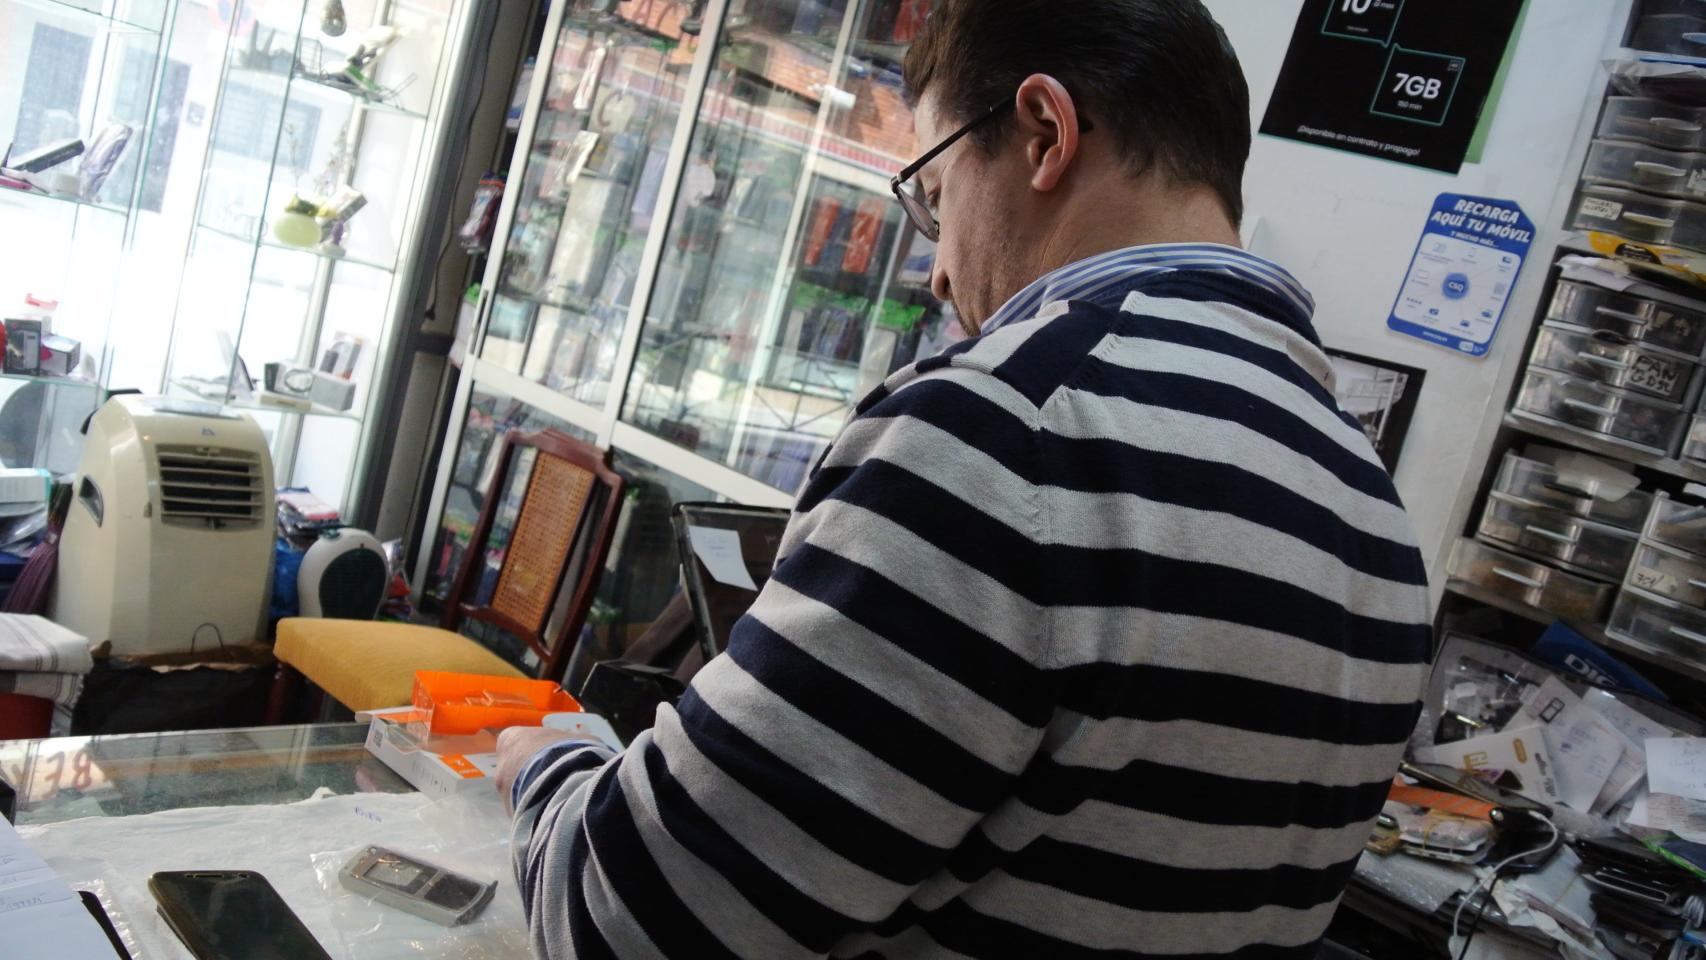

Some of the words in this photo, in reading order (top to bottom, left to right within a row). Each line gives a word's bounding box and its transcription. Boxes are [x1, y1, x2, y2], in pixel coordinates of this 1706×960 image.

[1393, 72, 1442, 99] 7GB
[1454, 199, 1520, 224] RECARGA
[1431, 211, 1467, 227] AQUÍ
[1467, 218, 1487, 232] TU
[1486, 223, 1531, 243] MÓVIL
